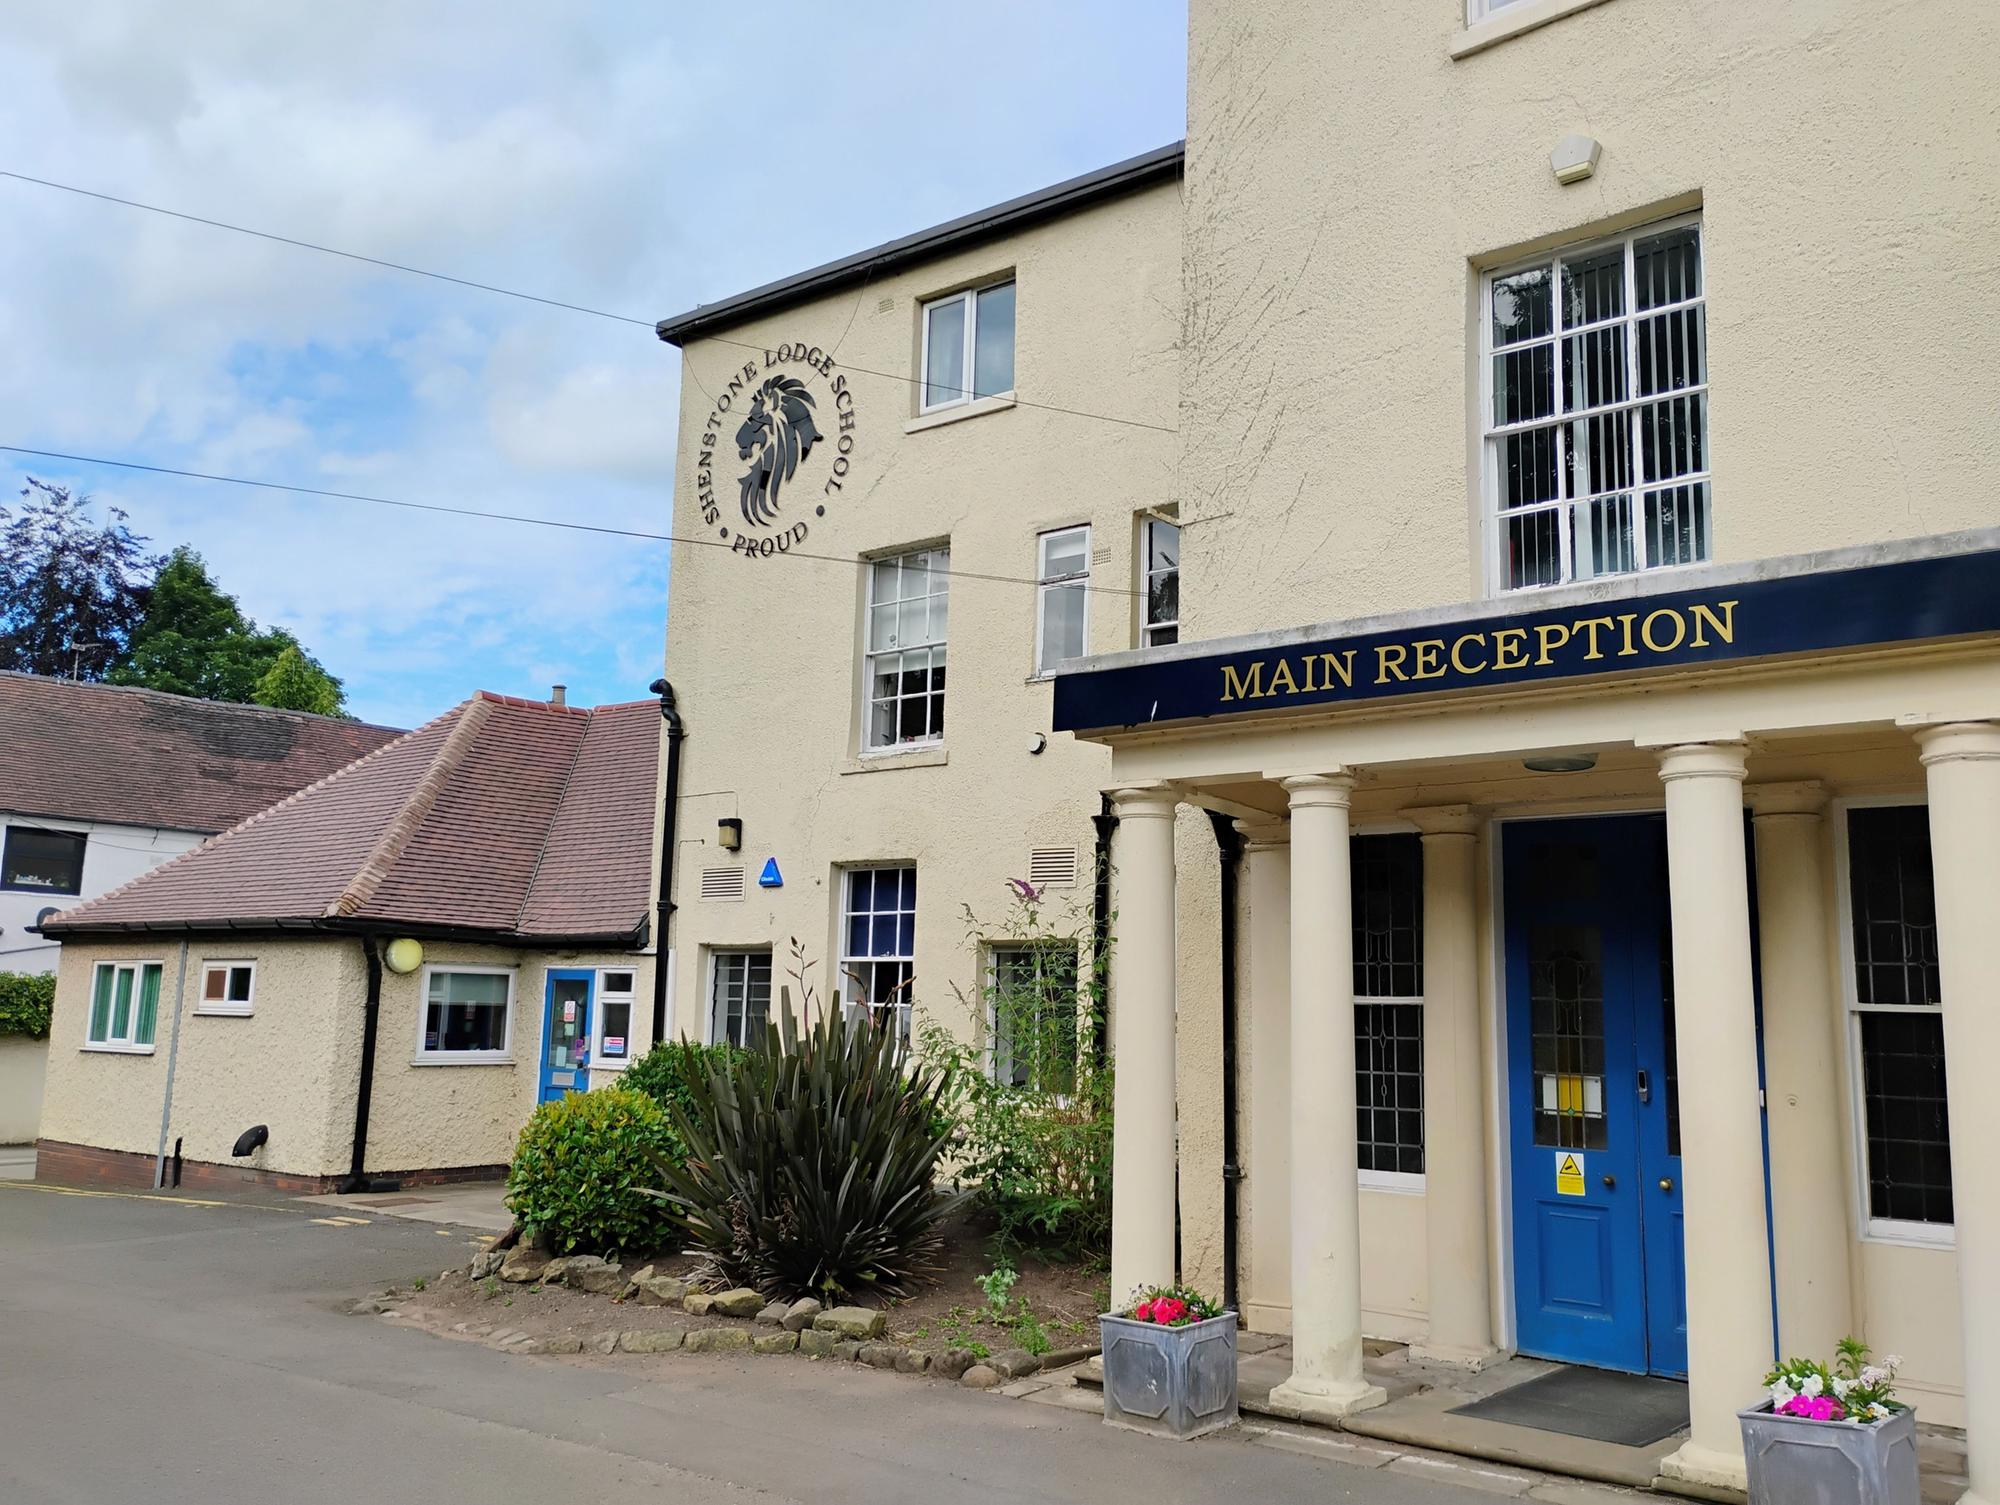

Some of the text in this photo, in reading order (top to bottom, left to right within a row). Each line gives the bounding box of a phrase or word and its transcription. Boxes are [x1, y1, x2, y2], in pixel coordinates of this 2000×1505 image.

[698, 343, 855, 525] SHENSTONE LODGE SCHOOL
[731, 521, 808, 558] PROUD
[1219, 600, 1739, 701] MAIN RECEPTION
